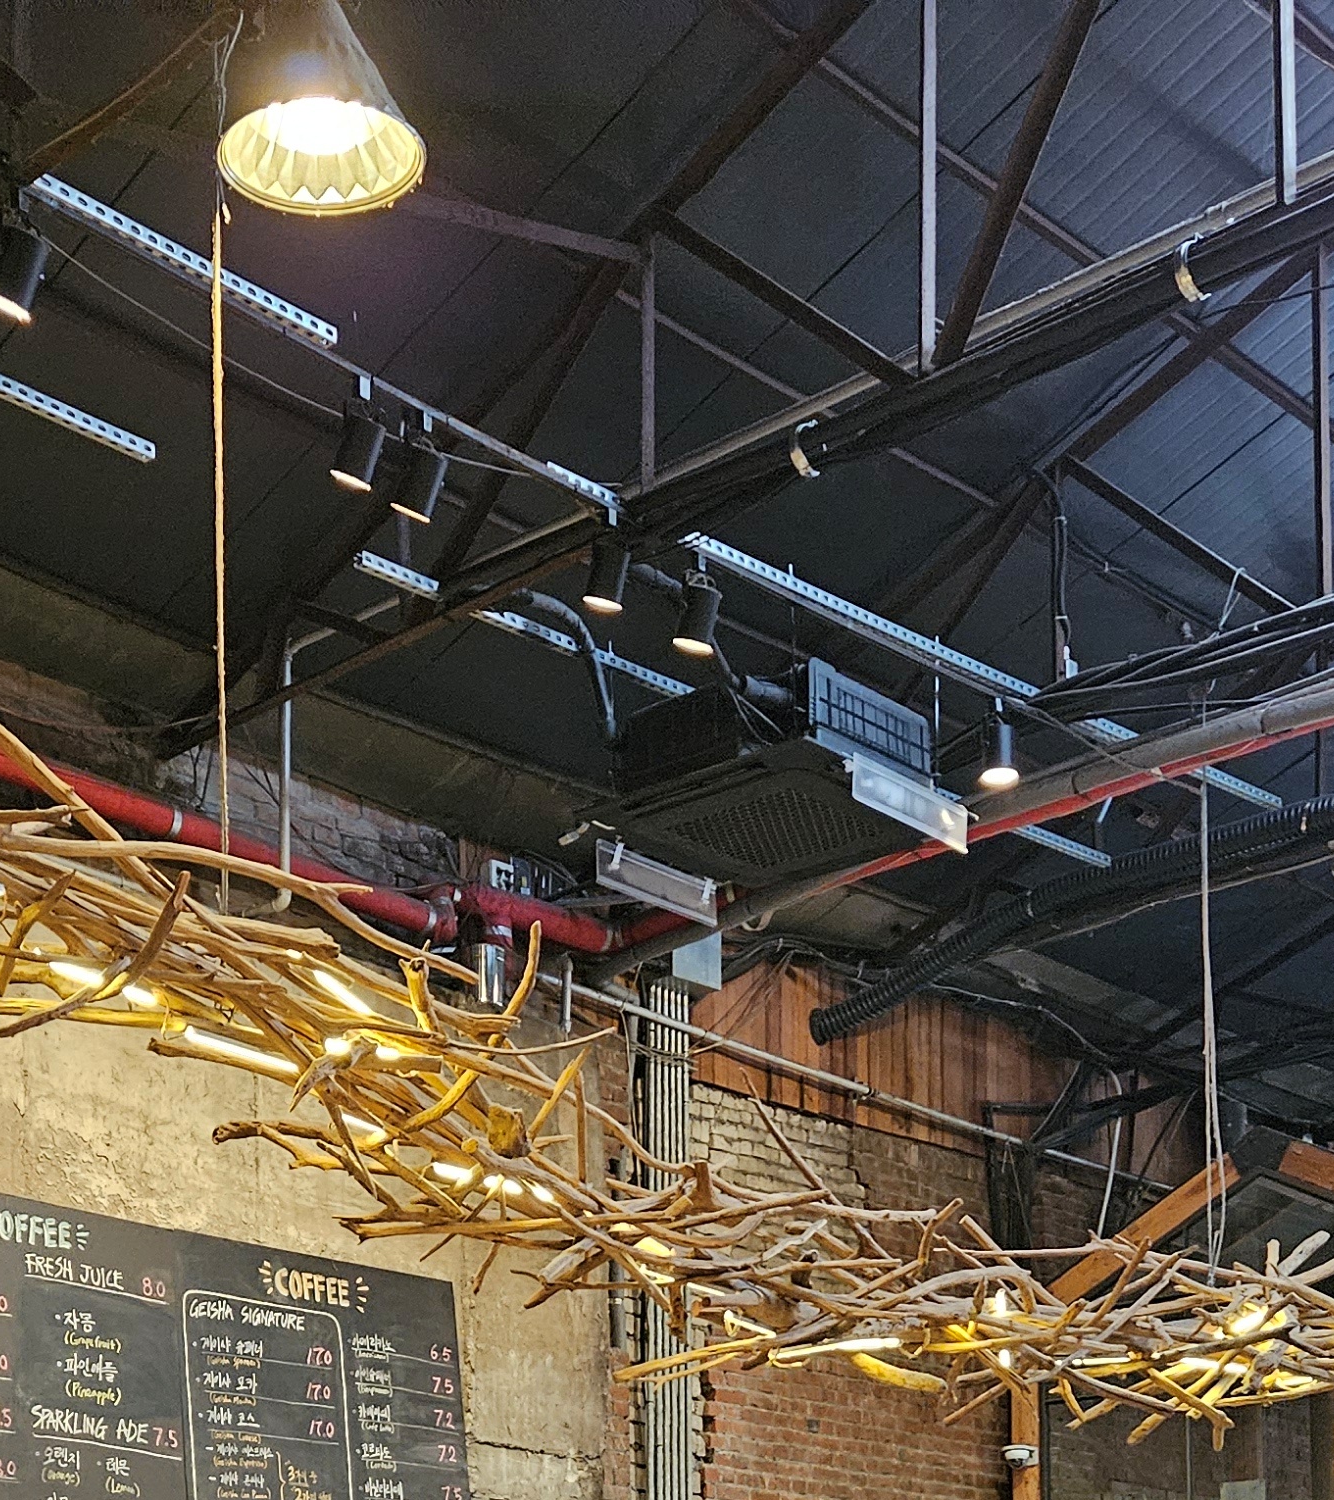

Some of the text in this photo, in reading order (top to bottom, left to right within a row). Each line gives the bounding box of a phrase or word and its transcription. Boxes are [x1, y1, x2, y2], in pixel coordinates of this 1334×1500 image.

[25, 1253, 124, 1290] FRESH JUICE
[142, 1277, 165, 1297] 8.0
[275, 1267, 350, 1307] COFFEE
[64, 1309, 96, 1333] 자몽
[189, 1299, 305, 1331] GEISHA SIGNATURE
[430, 1344, 452, 1361] 6.5
[64, 1353, 118, 1382] 파인애플
[65, 1379, 122, 1406] (Pineapple)
[306, 1382, 331, 1401] 17.0
[432, 1377, 454, 1393] 7.5
[31, 1405, 149, 1444] SPARKLING ADE
[309, 1420, 335, 1438] 17.0
[434, 1410, 455, 1429] 7.2
[153, 1427, 178, 1448] 7.5
[438, 1445, 457, 1463] 7.2
[106, 1457, 130, 1476] 레몬
